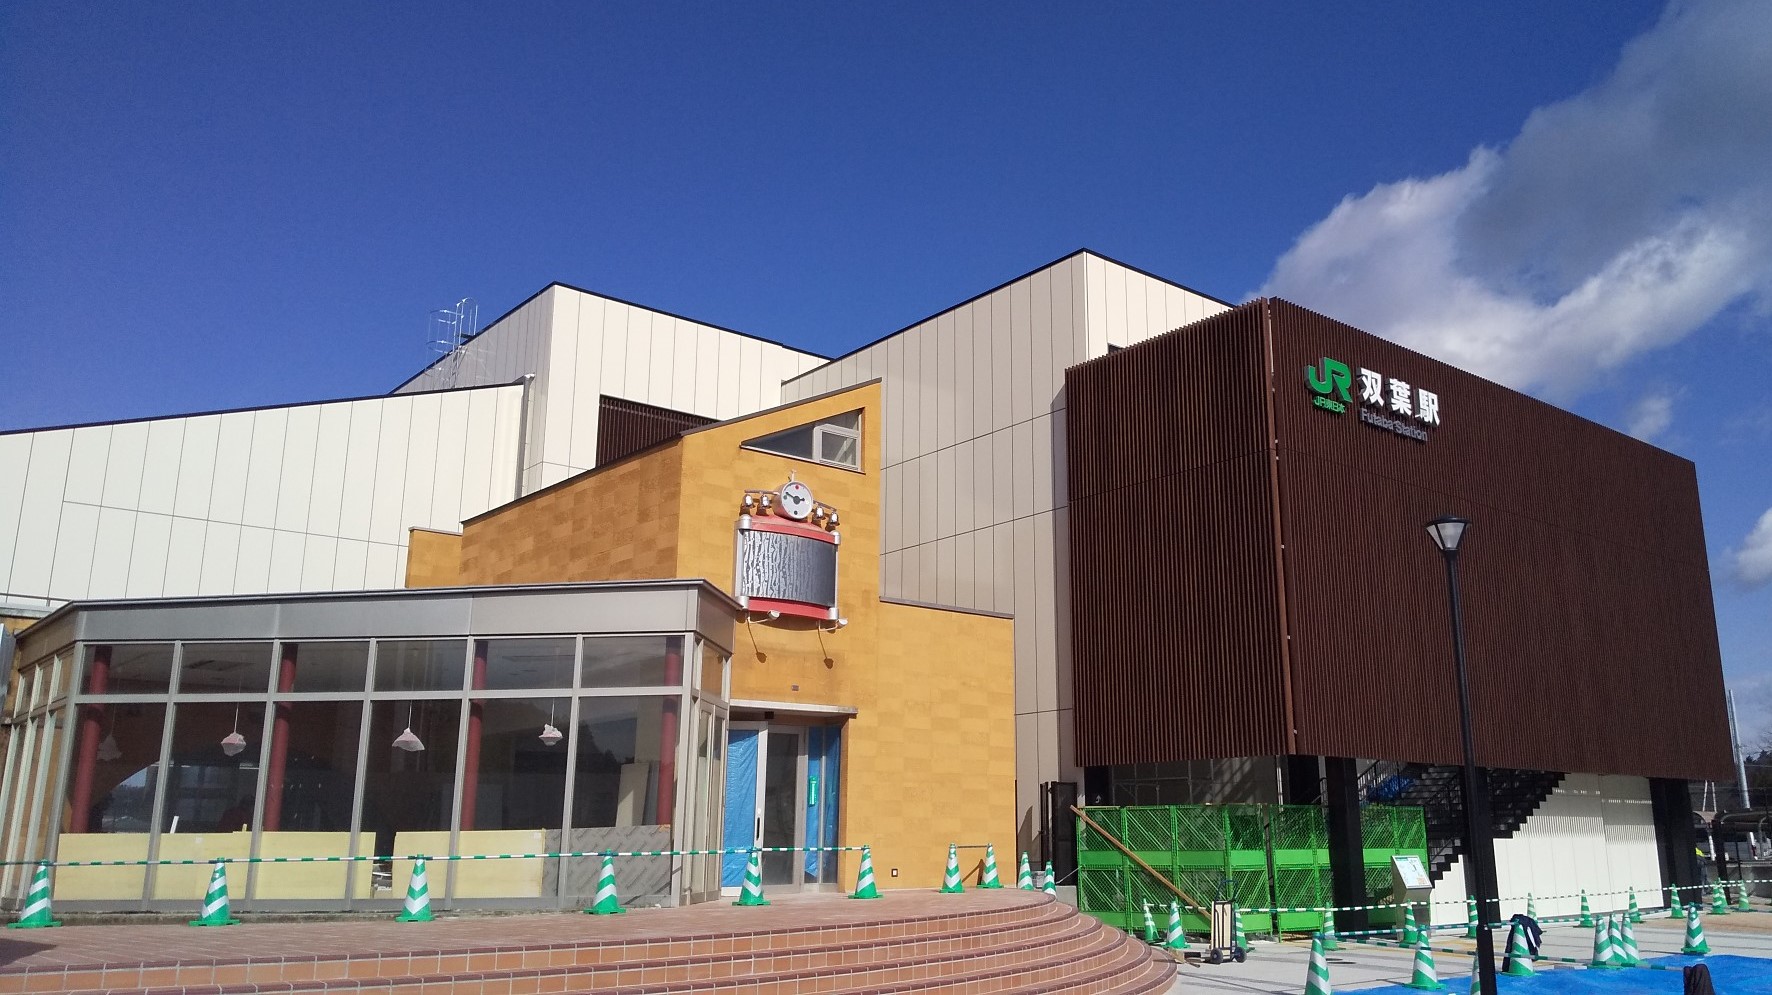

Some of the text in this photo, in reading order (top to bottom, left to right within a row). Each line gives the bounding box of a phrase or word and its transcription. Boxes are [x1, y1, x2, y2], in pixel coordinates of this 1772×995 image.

[1308, 357, 1353, 402] JR
[1360, 367, 1440, 426] 双葉駅
[1361, 407, 1428, 441] Futaba Station
